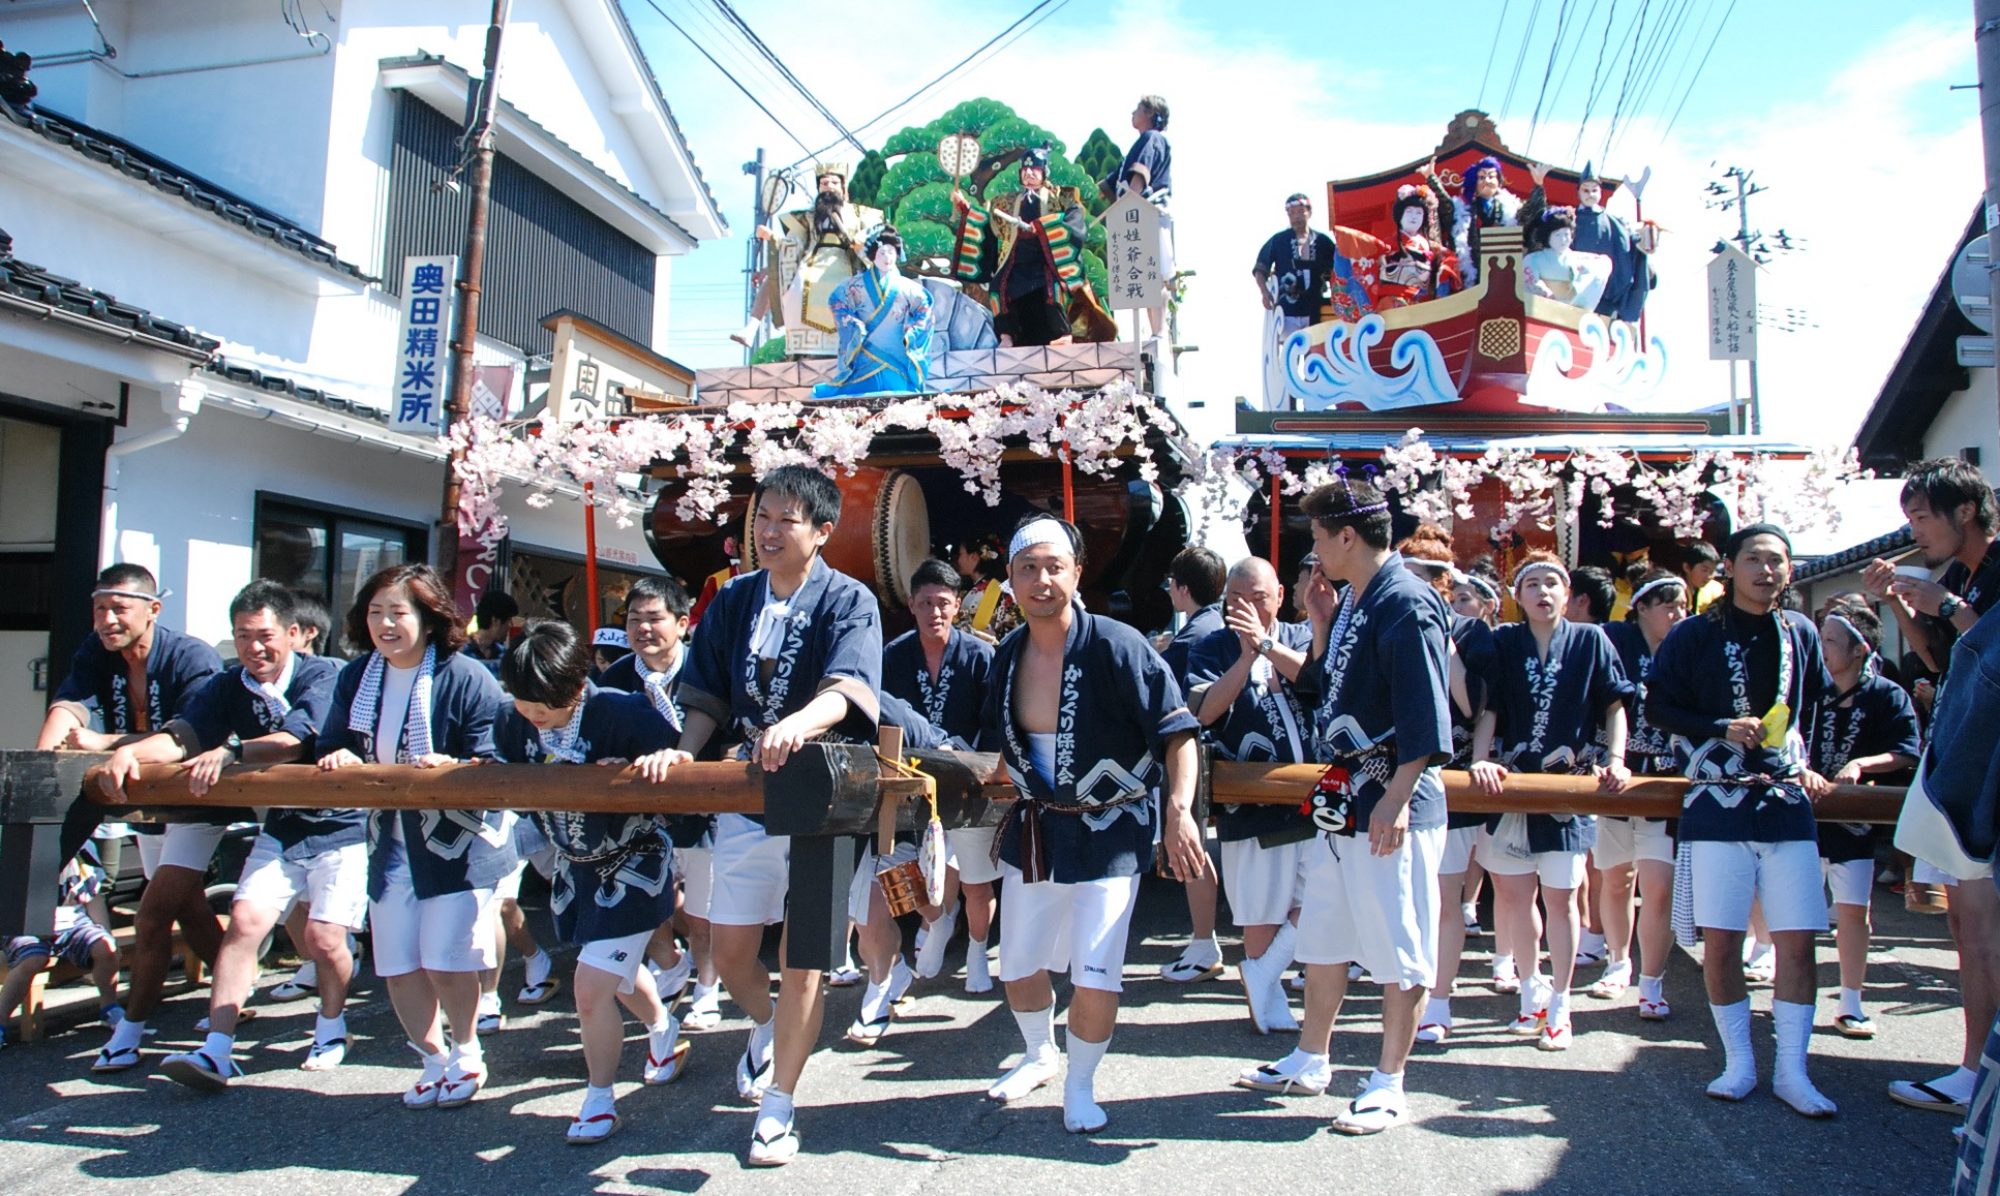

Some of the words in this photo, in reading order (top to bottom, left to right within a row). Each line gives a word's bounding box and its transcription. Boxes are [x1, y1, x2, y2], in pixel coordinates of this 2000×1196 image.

[398, 263, 444, 424] 奥田精米所
